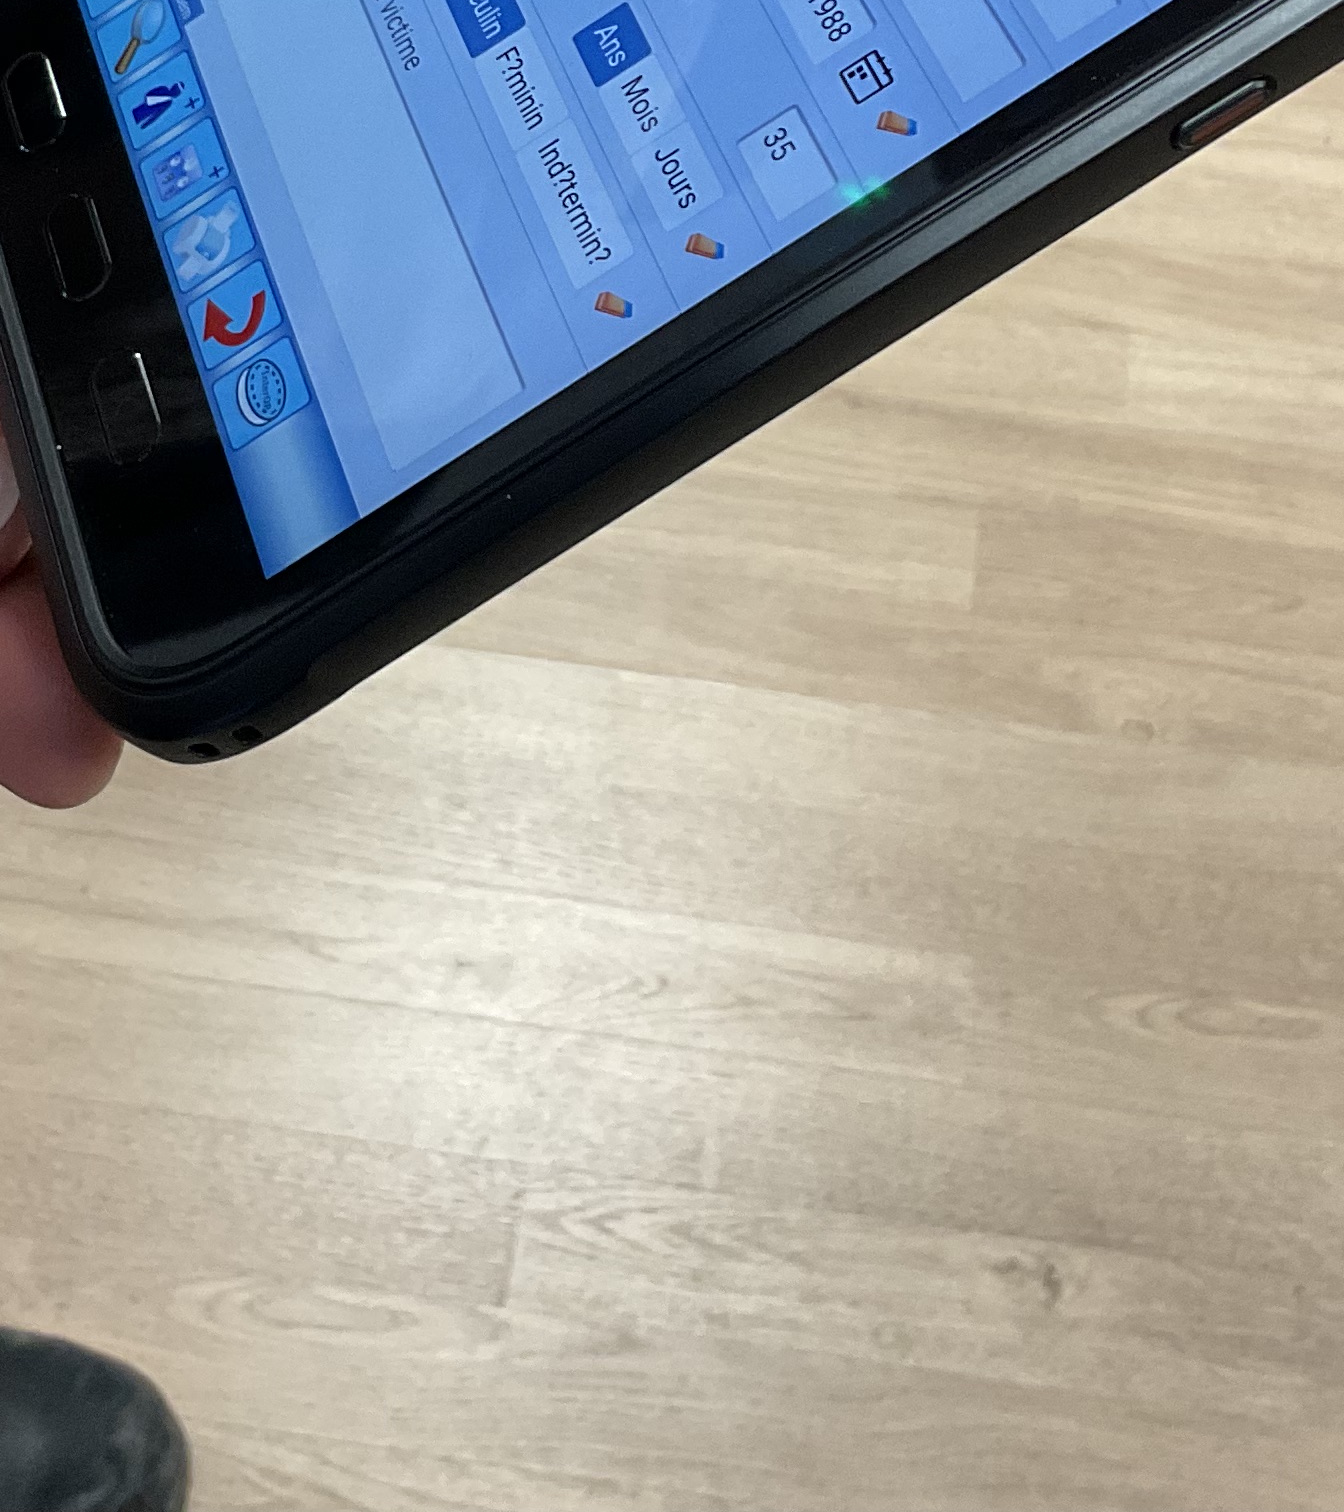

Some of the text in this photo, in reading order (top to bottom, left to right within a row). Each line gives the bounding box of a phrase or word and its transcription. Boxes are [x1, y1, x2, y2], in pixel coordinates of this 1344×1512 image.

[594, 24, 626, 67] Ans
[496, 46, 543, 132] F?minin
[621, 75, 659, 133] Mois
[763, 127, 796, 161] 35
[538, 138, 612, 266] Ind?termin?
[655, 148, 697, 210] Jours
